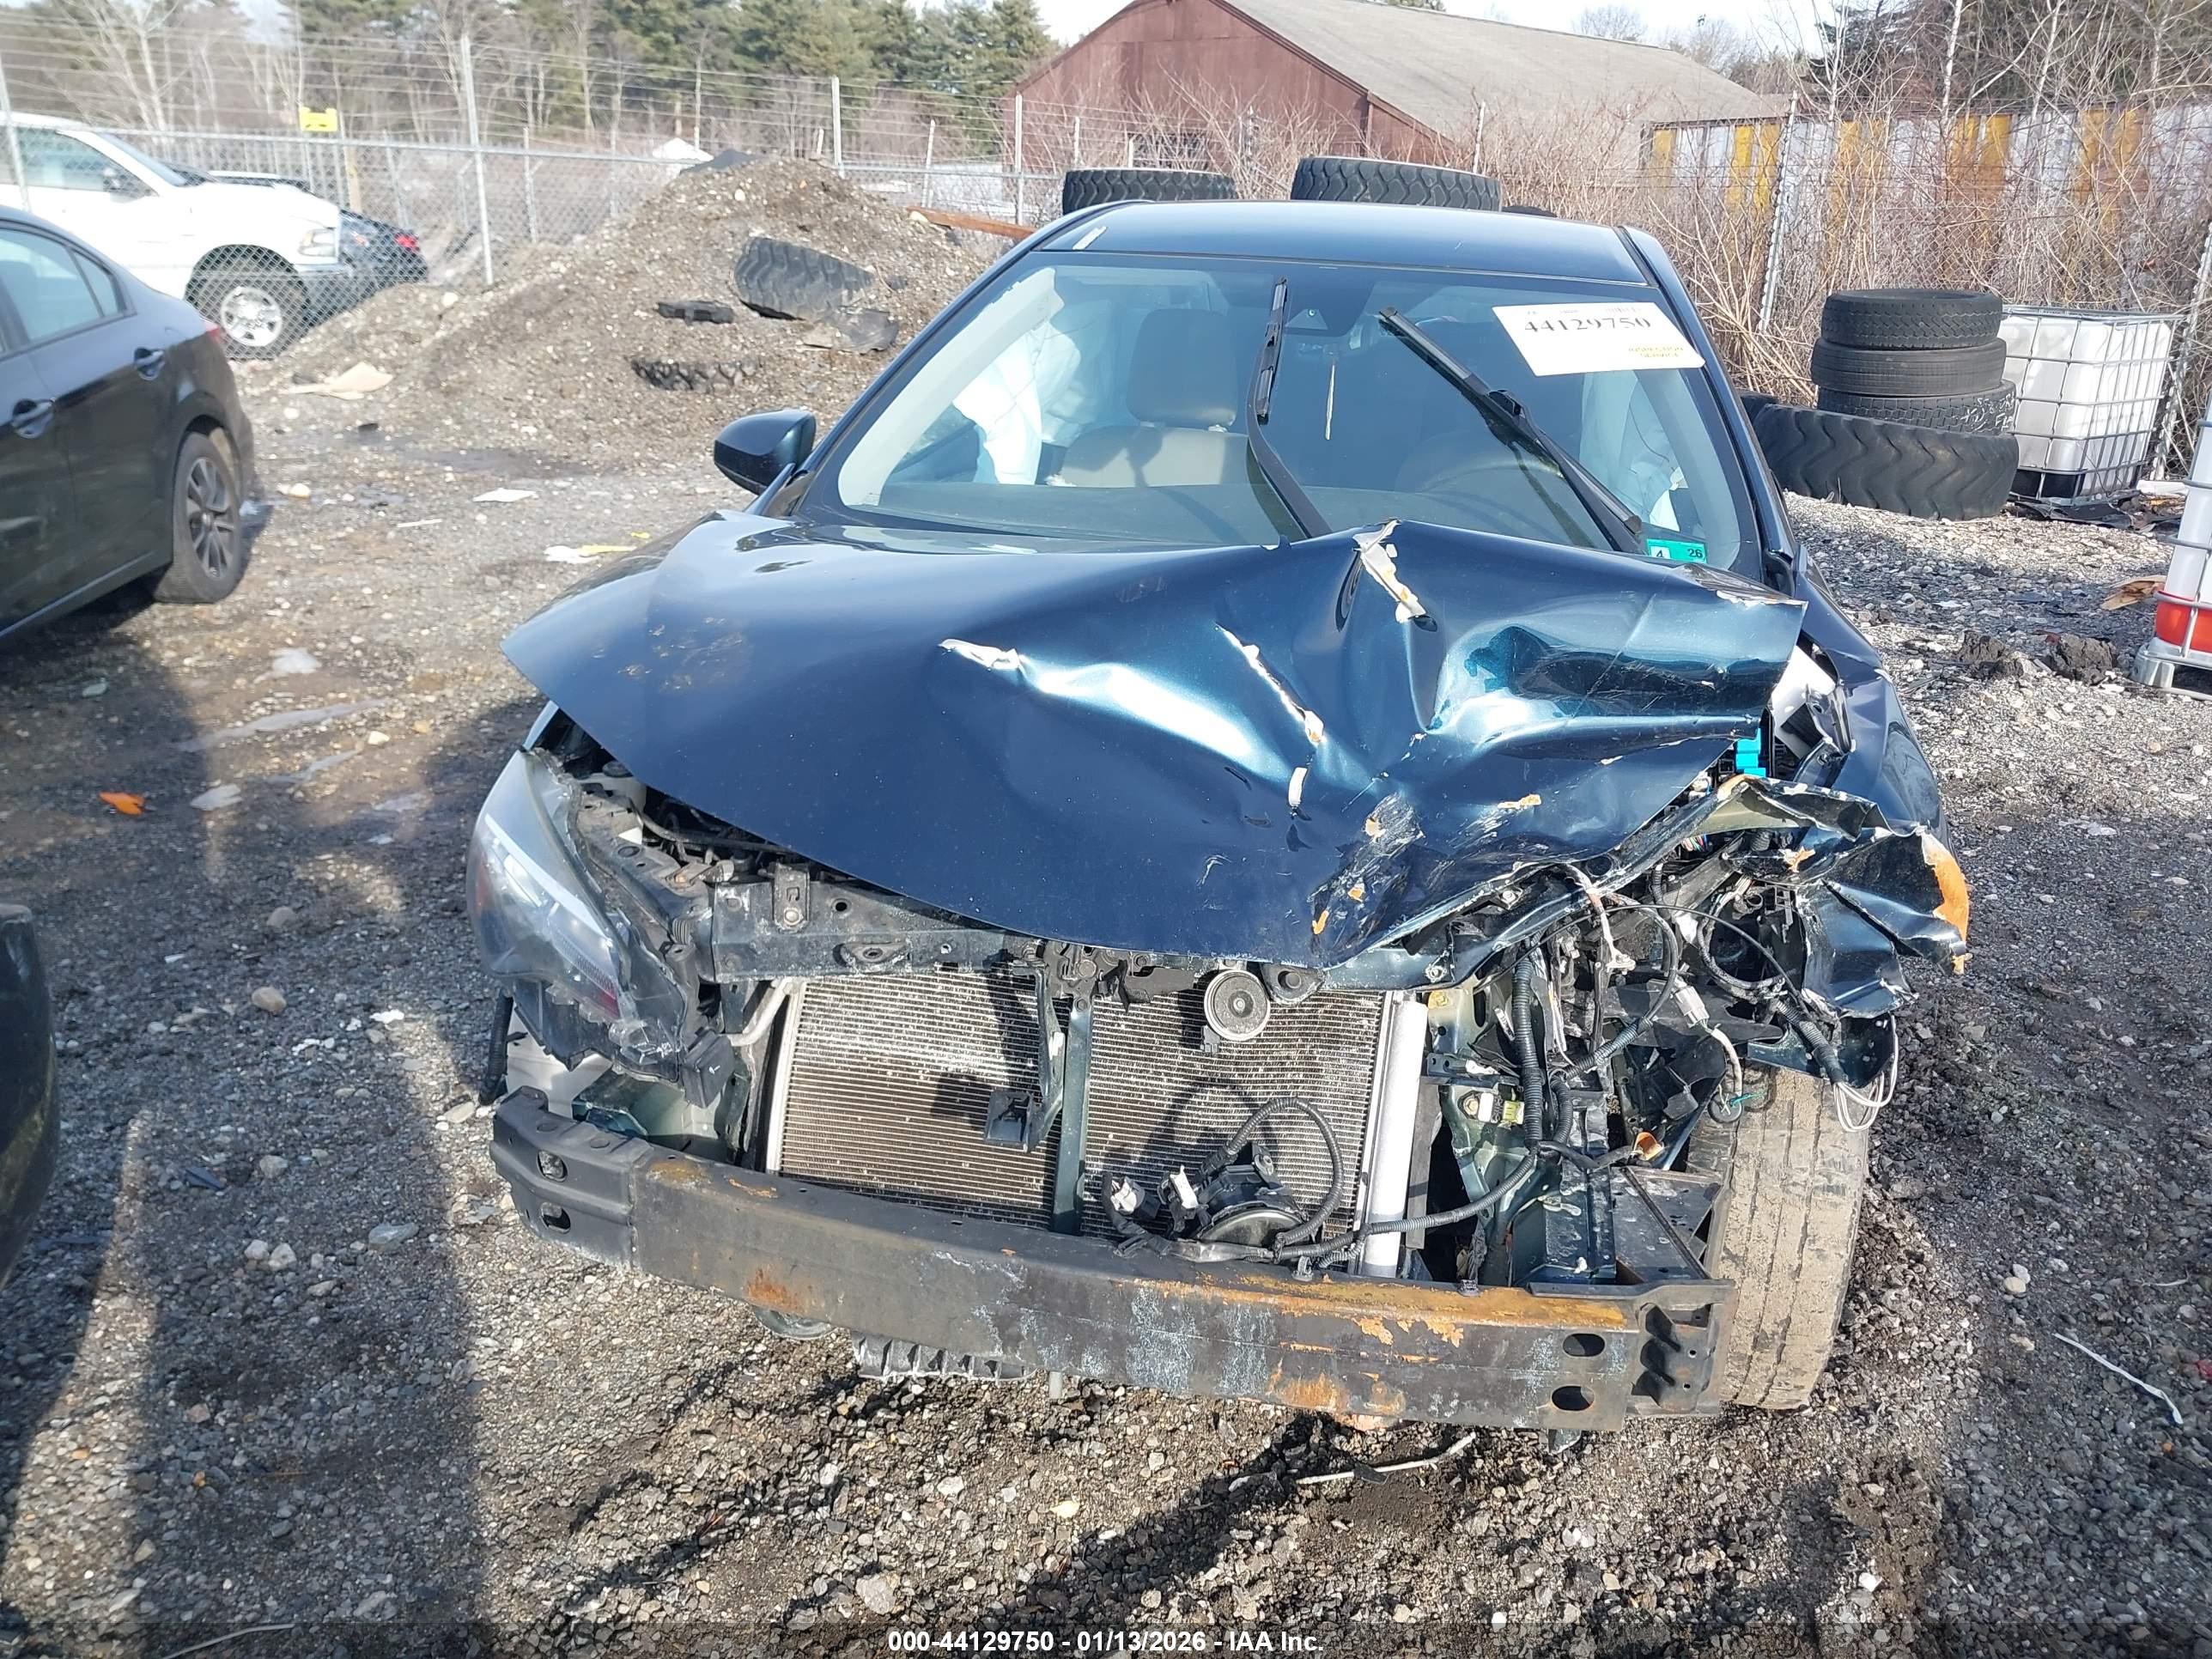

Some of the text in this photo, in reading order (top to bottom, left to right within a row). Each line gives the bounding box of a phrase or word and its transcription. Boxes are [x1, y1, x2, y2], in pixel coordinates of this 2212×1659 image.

[1524, 318, 1650, 331] 44129750
[1656, 549, 1704, 558] 4 26
